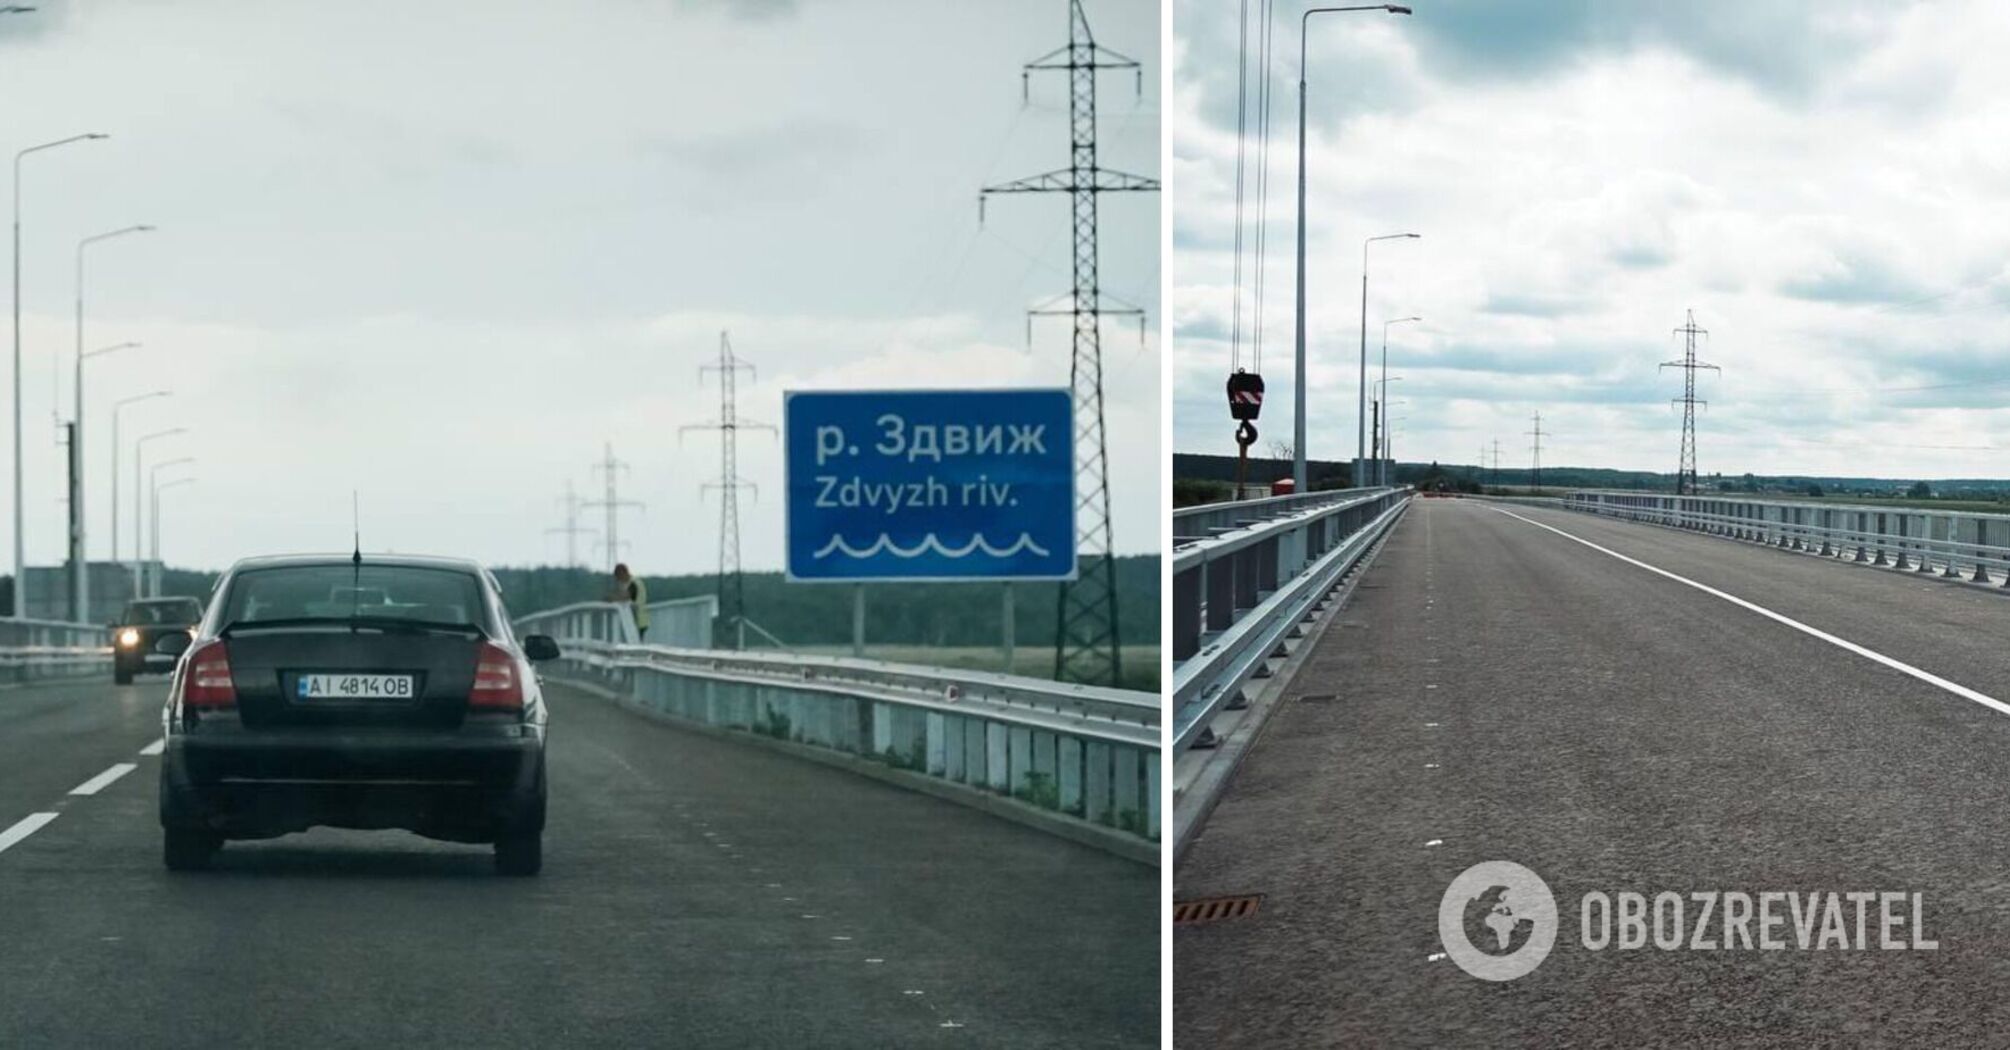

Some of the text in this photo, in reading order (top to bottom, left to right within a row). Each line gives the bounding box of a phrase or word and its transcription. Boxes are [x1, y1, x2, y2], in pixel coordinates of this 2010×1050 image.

[816, 413, 1047, 466] р. Здвиж
[814, 475, 1019, 514] Zdvyzh riv.
[310, 677, 409, 695] AI 4814 OB
